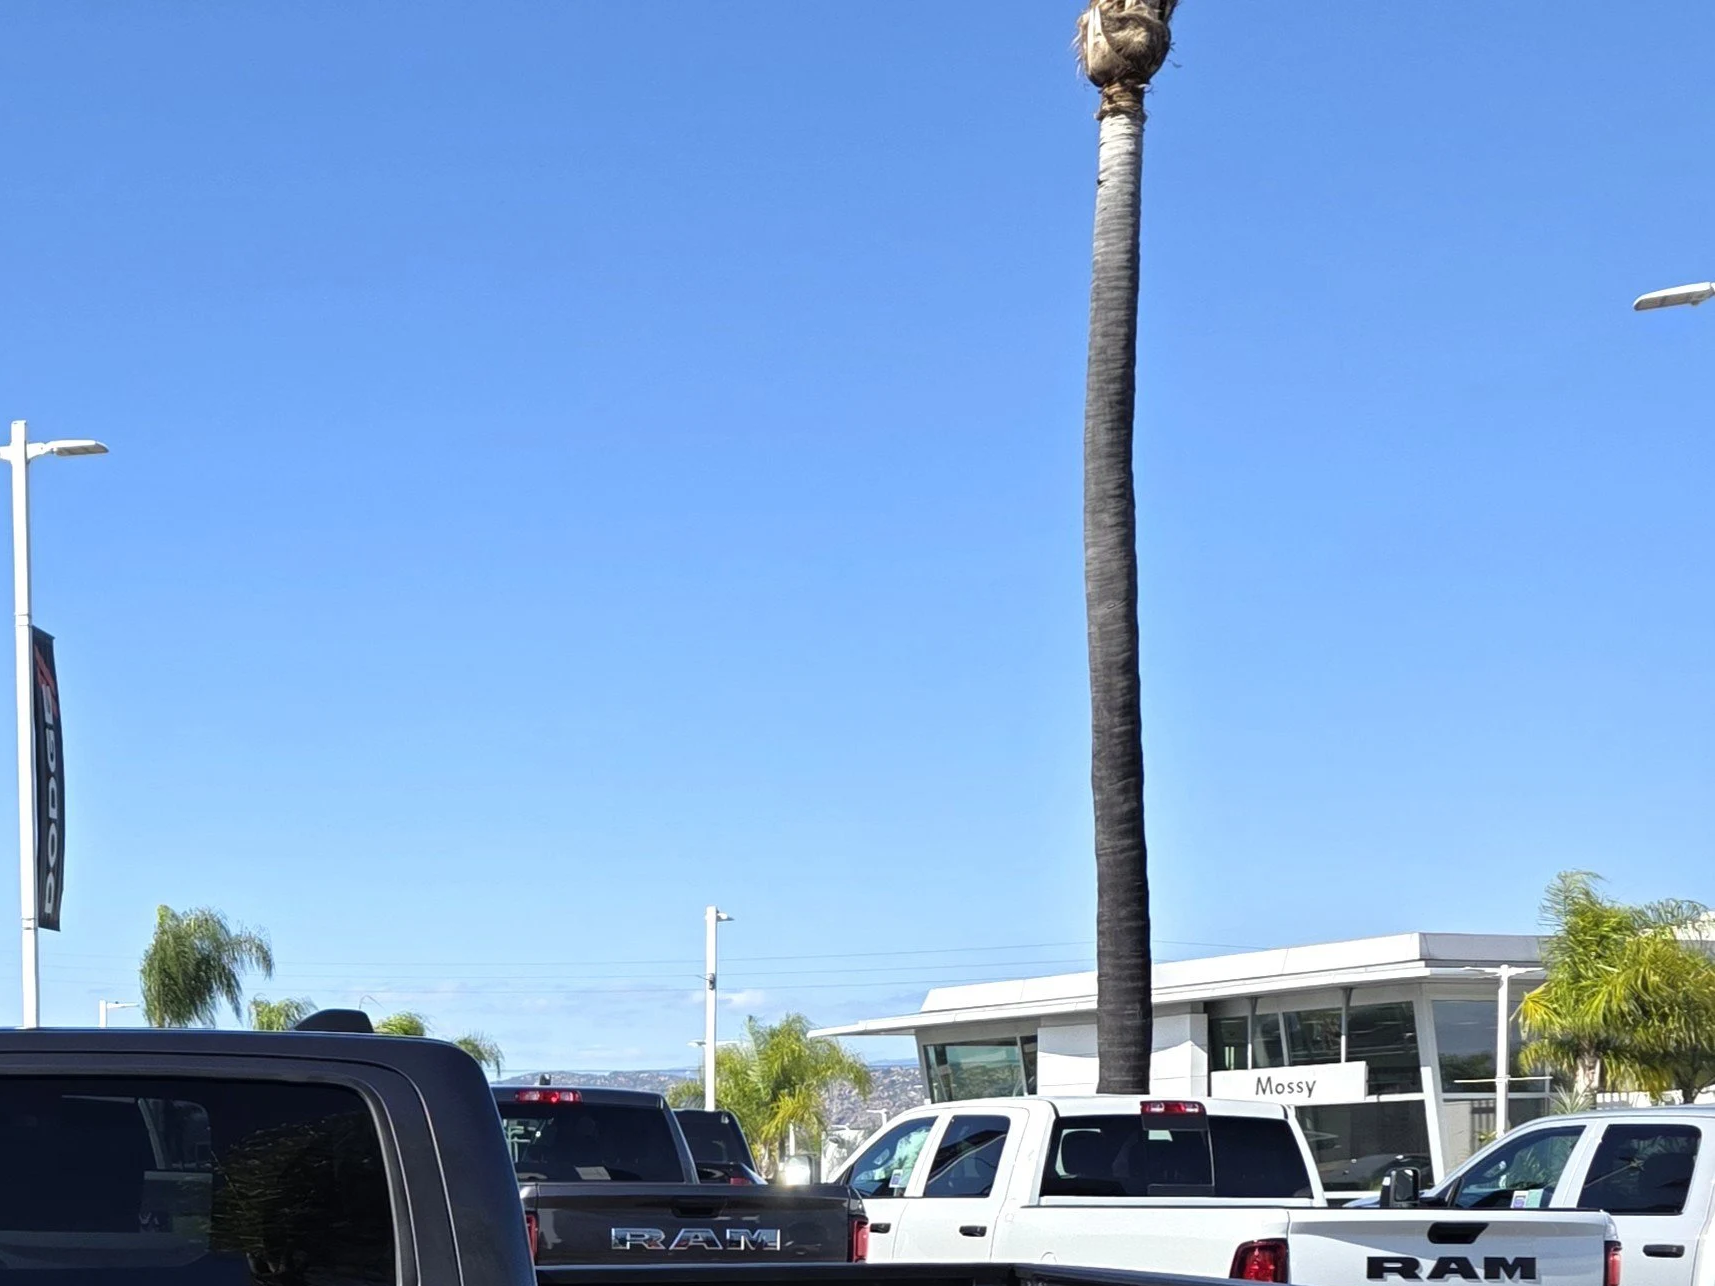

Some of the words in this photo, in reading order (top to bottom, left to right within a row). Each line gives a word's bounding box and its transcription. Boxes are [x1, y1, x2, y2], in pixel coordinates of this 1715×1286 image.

[42, 684, 58, 914] DODGE
[1255, 1076, 1317, 1098] Mossy
[611, 1227, 781, 1251] RAM
[1366, 1256, 1537, 1281] RAM
